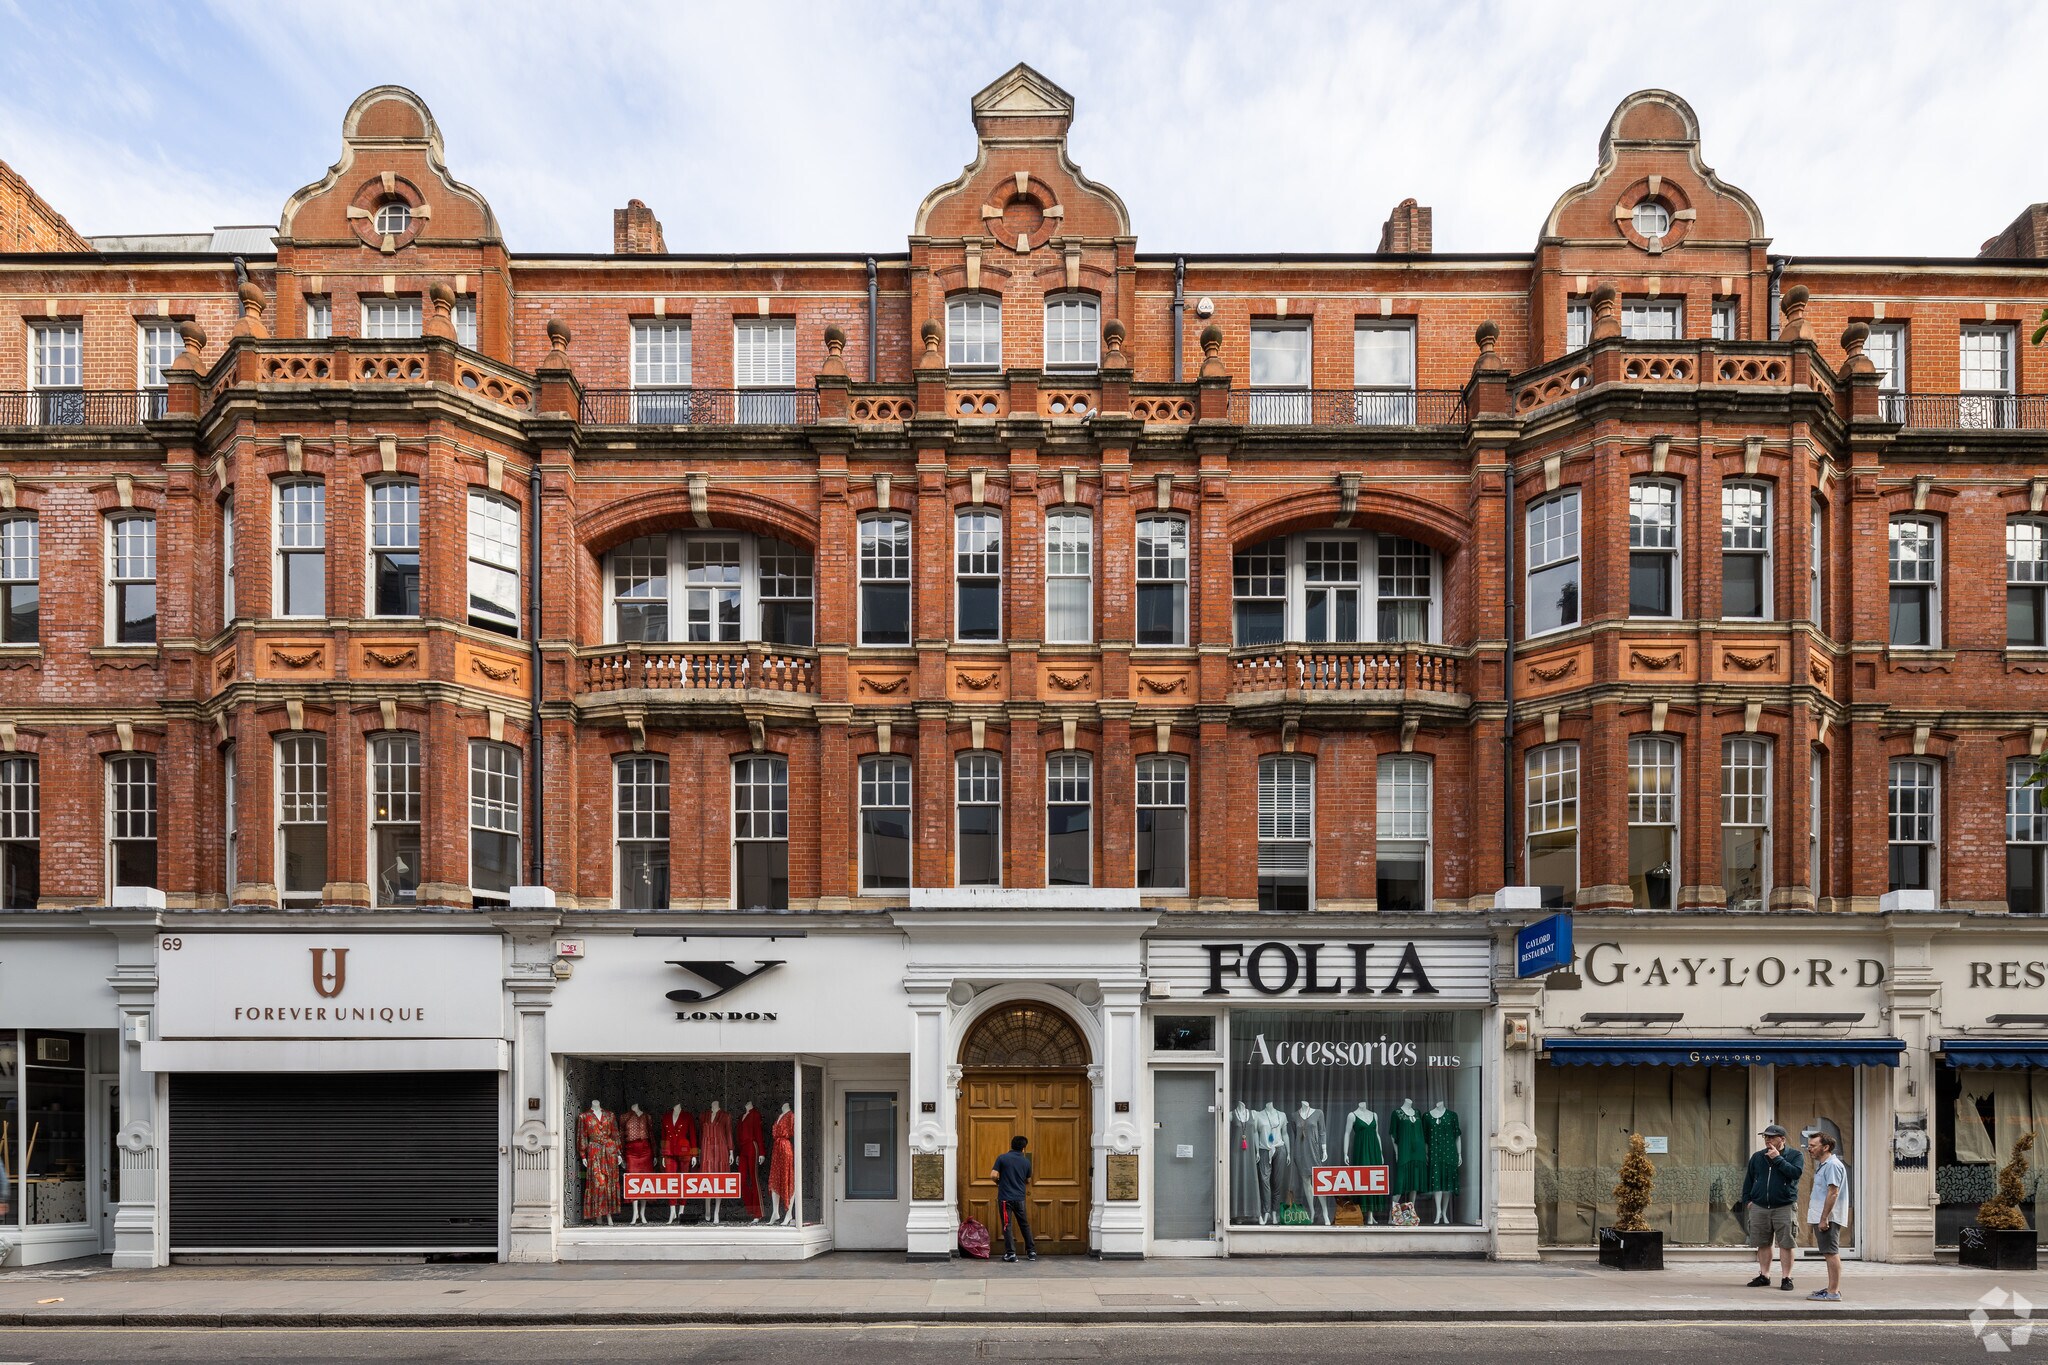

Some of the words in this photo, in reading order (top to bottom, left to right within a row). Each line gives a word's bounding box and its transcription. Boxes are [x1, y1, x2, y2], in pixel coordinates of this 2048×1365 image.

[162, 937, 182, 951] 69
[1525, 933, 1551, 949] GAYLORD
[1521, 942, 1555, 962] RESTAURANT
[1201, 941, 1440, 995] FOLIA
[1969, 960, 2048, 990] RES
[234, 1007, 327, 1021] FOREVER
[335, 1007, 424, 1023] UNIQUE
[675, 1011, 779, 1022] LONDON
[1179, 1029, 1190, 1038] 77
[1247, 1033, 1417, 1067] Accessories
[1428, 1055, 1461, 1067] PLUS
[923, 1103, 934, 1111] 73
[1117, 1103, 1128, 1111] 75
[627, 1177, 679, 1195] SALE
[685, 1177, 737, 1195] SALE
[1316, 1169, 1385, 1192] SALE
